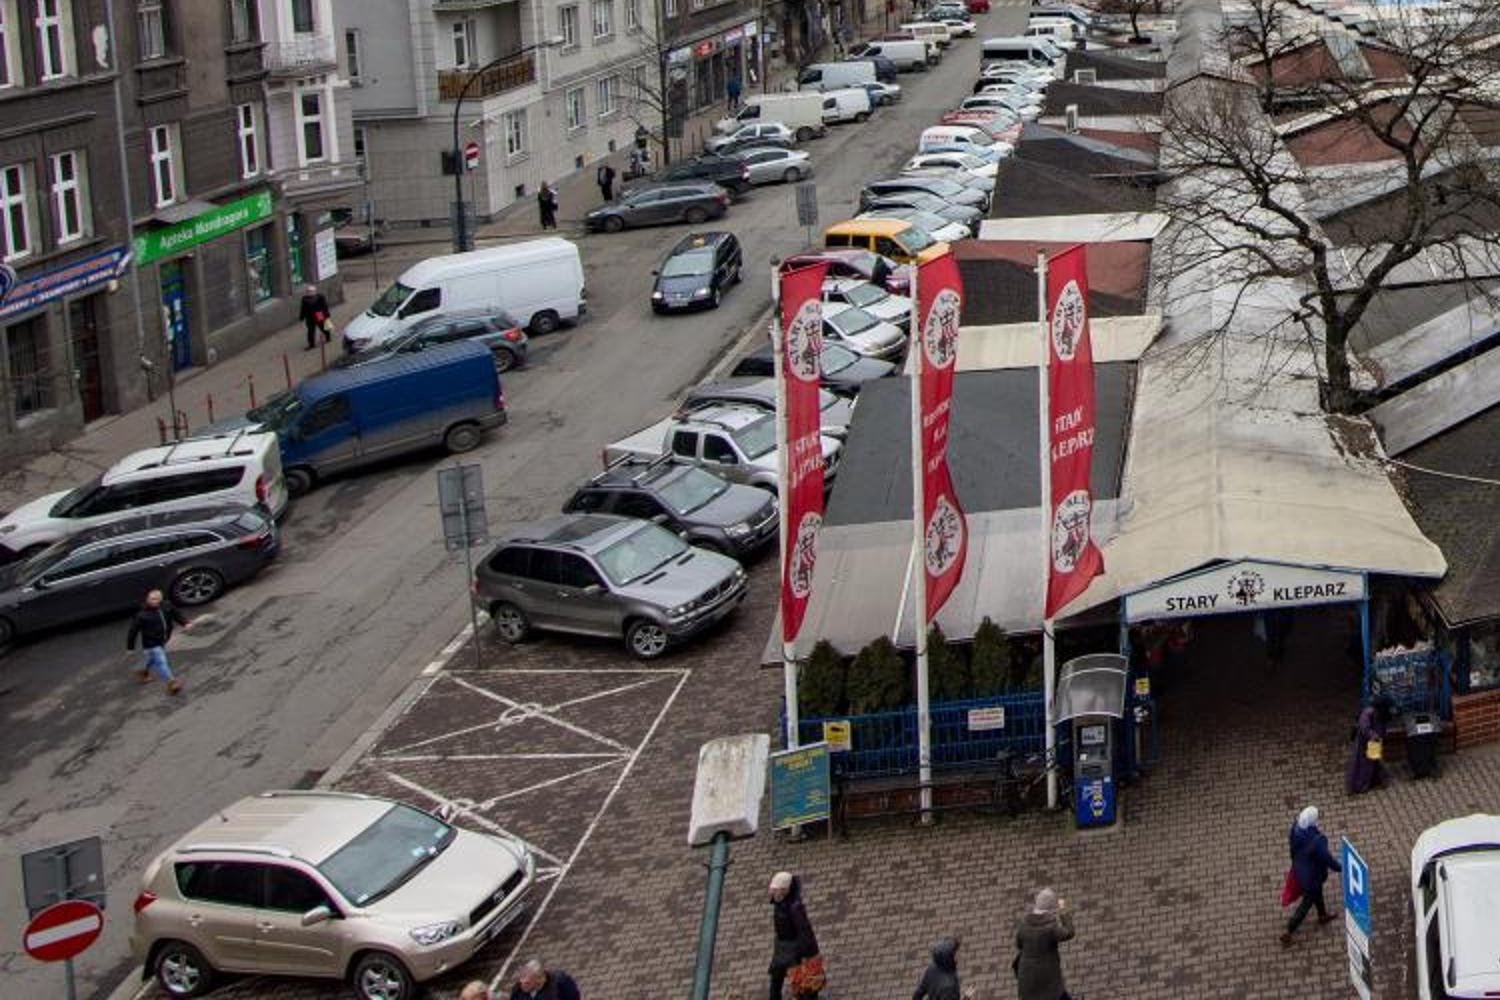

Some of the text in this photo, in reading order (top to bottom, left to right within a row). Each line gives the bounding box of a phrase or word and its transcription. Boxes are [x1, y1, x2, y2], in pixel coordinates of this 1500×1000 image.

[159, 228, 194, 249] Apteka
[1165, 593, 1220, 612] STARY
[1273, 581, 1347, 602] KLEPARZ
